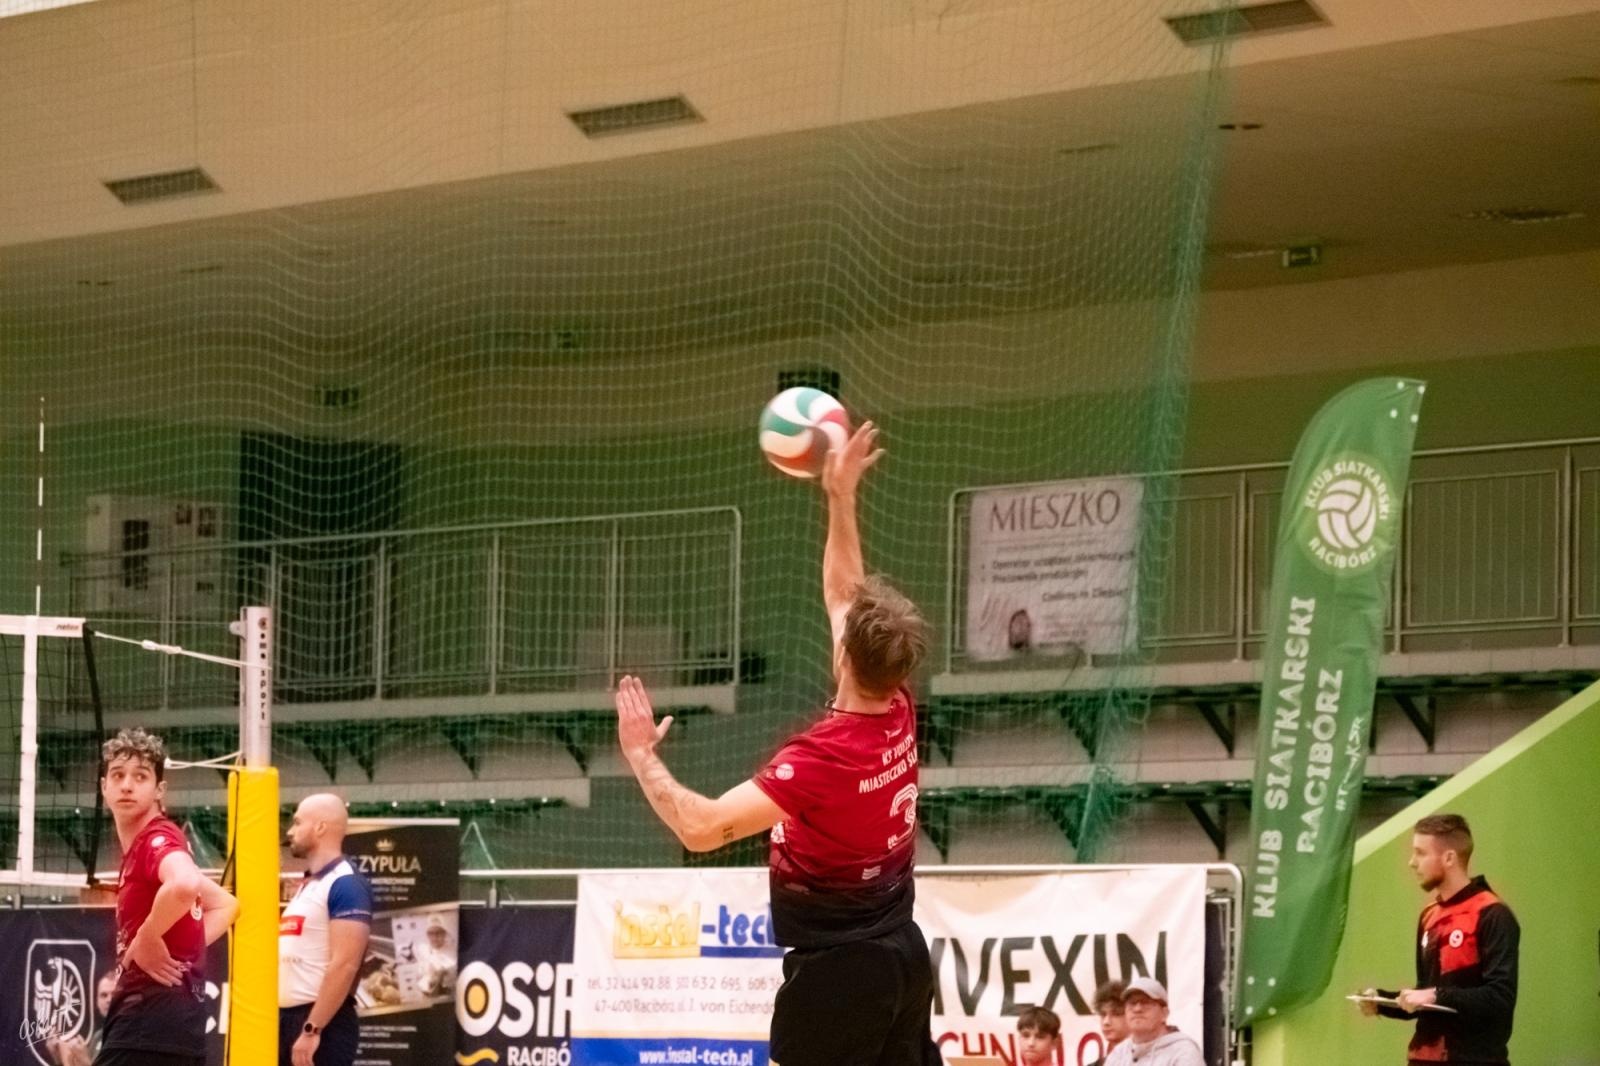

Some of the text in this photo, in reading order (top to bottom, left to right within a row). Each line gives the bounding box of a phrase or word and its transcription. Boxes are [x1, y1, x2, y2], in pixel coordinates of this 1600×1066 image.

[990, 489, 1121, 532] MIESZKO
[1305, 461, 1390, 520] KLUB SIATKARSKI
[859, 758, 908, 794] MIASTECZKO
[1252, 596, 1316, 918] KLUB SIATKARSKI
[1297, 668, 1343, 853] RACIBÓRZ
[700, 1001, 725, 1013] von
